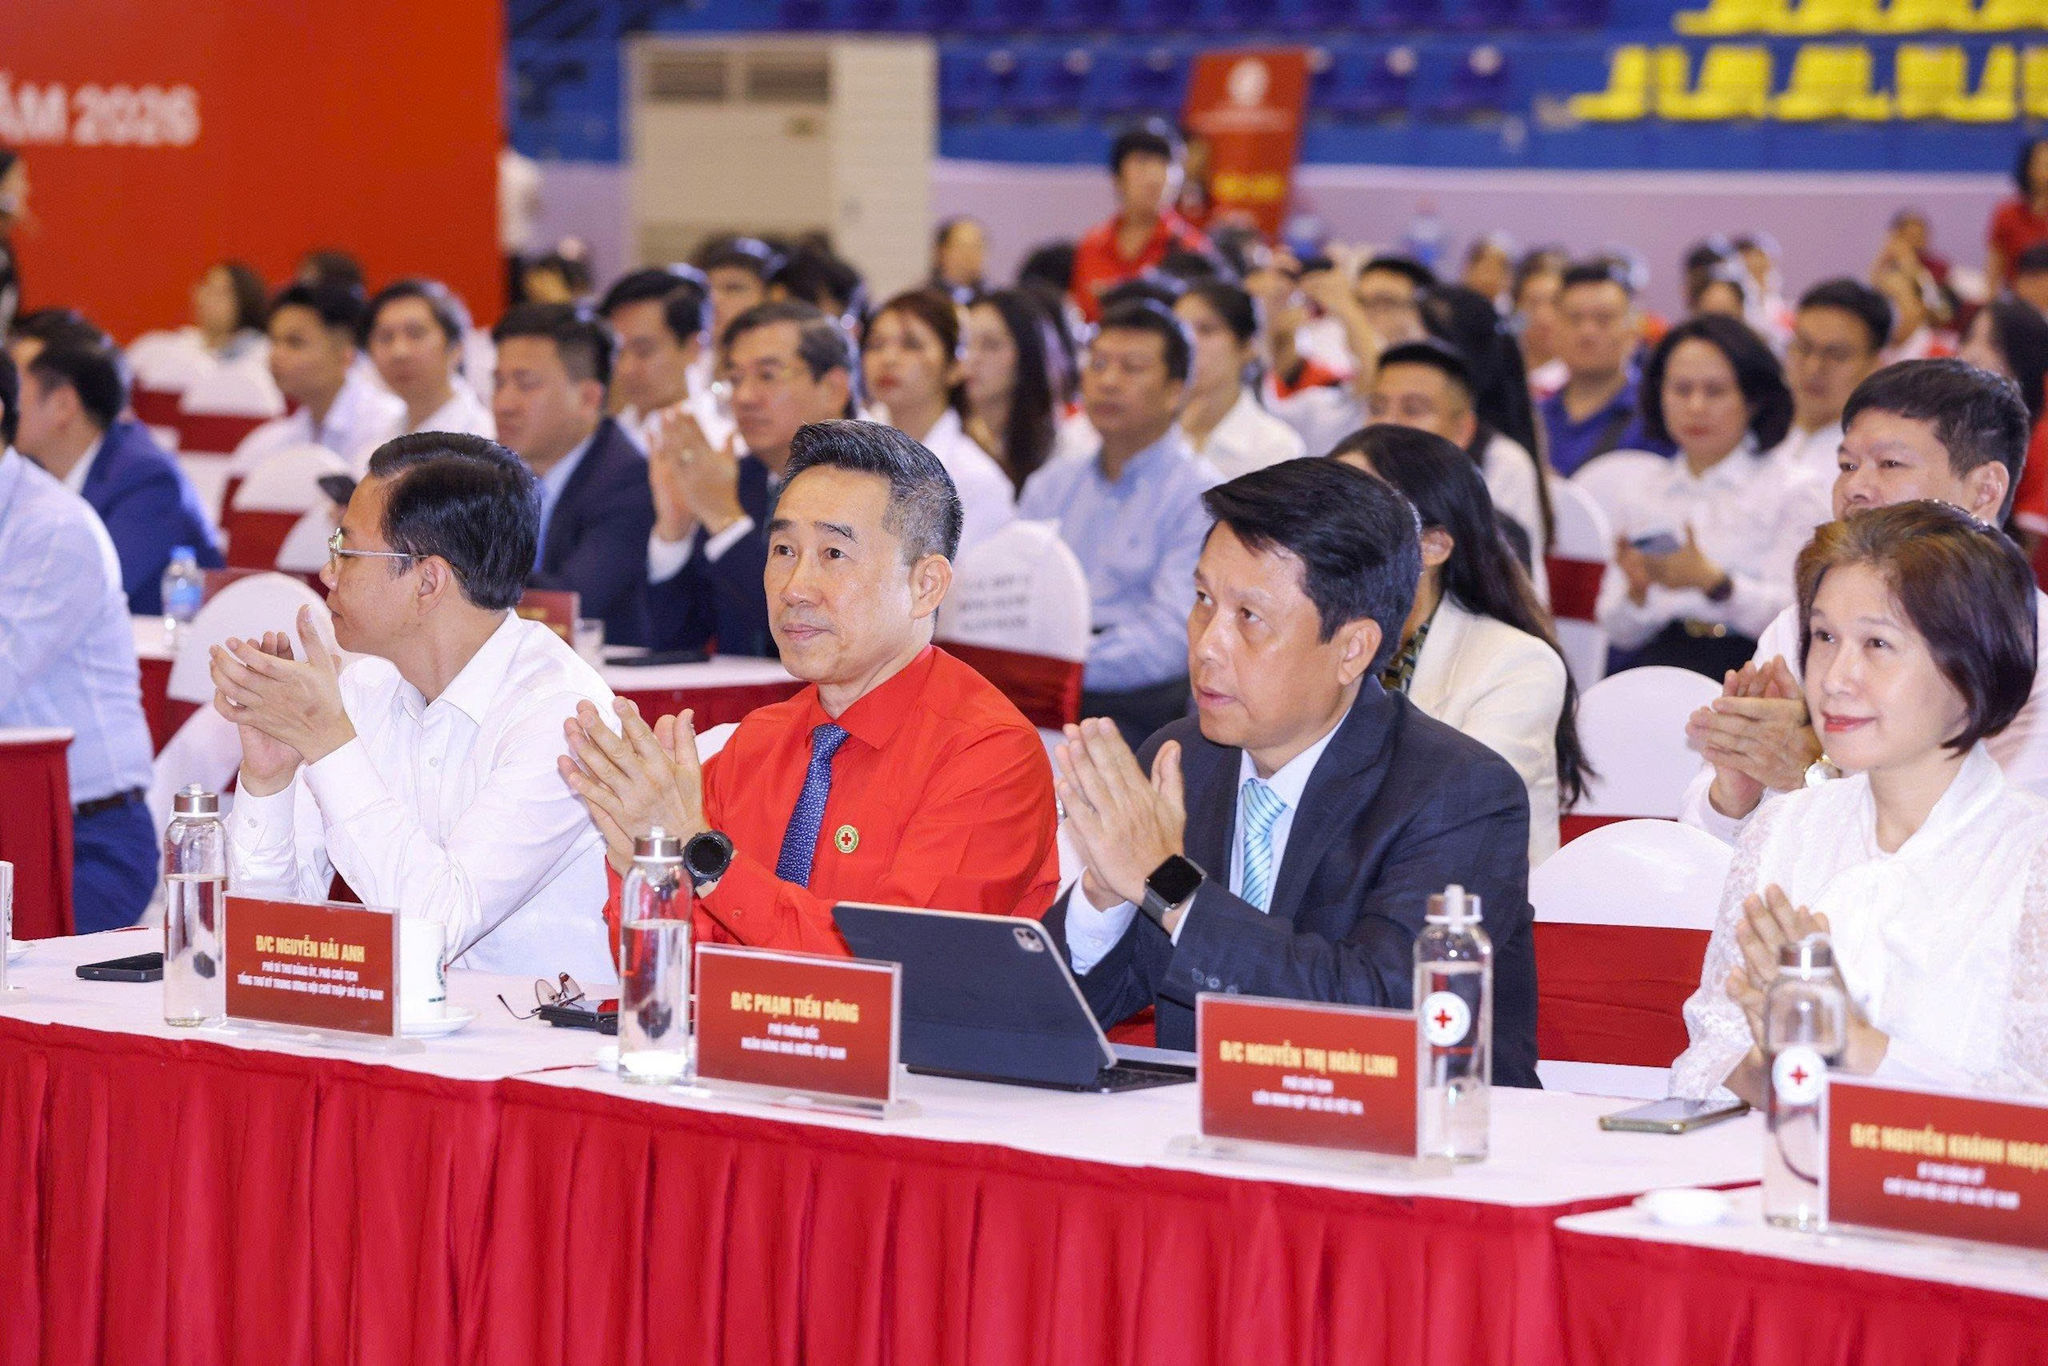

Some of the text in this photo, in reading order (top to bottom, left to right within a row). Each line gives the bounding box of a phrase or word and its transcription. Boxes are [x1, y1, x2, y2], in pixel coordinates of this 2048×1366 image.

[72, 81, 200, 146] 2026
[276, 934, 318, 958] NGUYỄN
[319, 937, 340, 960] HẢI
[341, 944, 366, 963] ANH
[754, 993, 791, 1019] PHẠM
[792, 993, 821, 1019] TIẾN
[1245, 1039, 1302, 1068] NGUYỄN
[1303, 1048, 1327, 1075] THỊ
[1328, 1048, 1363, 1075] HOÀI
[1363, 1053, 1398, 1078] LINH
[1881, 1123, 1947, 1159] NGUYỄN
[1947, 1131, 2005, 1165] KHÁNH
